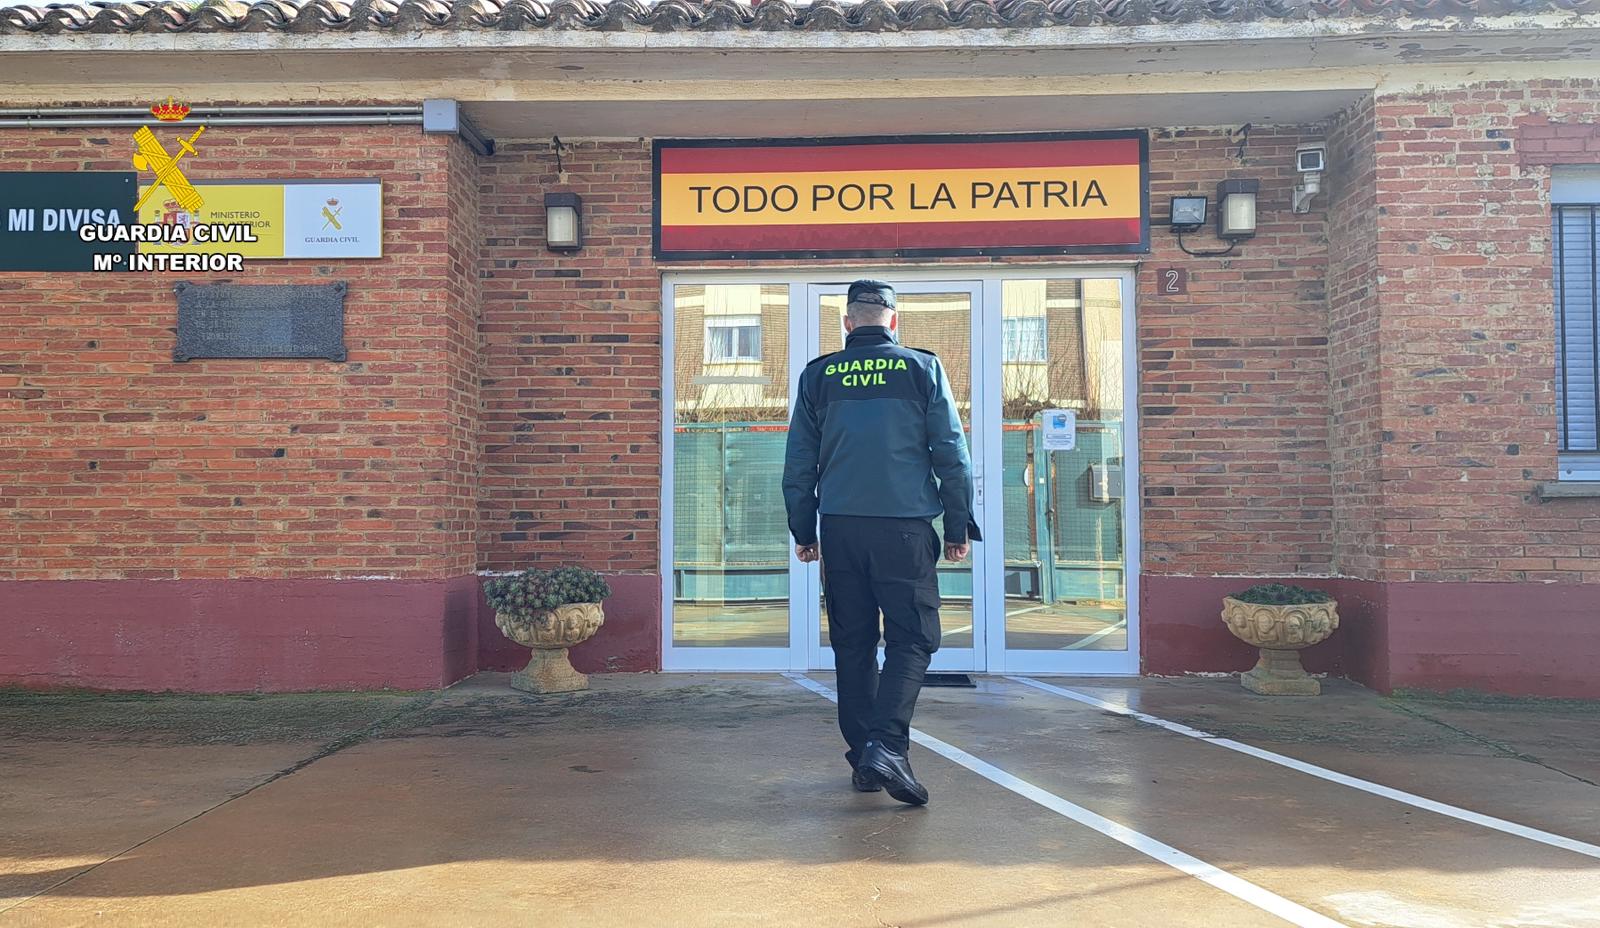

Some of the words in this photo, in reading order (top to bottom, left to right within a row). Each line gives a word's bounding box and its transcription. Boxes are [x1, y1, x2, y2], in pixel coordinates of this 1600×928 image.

[688, 184, 799, 213] TODO
[812, 183, 895, 211] POR
[909, 182, 957, 210] LA
[970, 179, 1109, 209] PATRIA
[8, 208, 35, 232] MI
[42, 208, 121, 232] DIVISA
[210, 211, 261, 219] MINISTERIO
[1165, 270, 1179, 292] 2
[825, 358, 908, 376] GUARDIA
[842, 372, 887, 387] CIVIL
